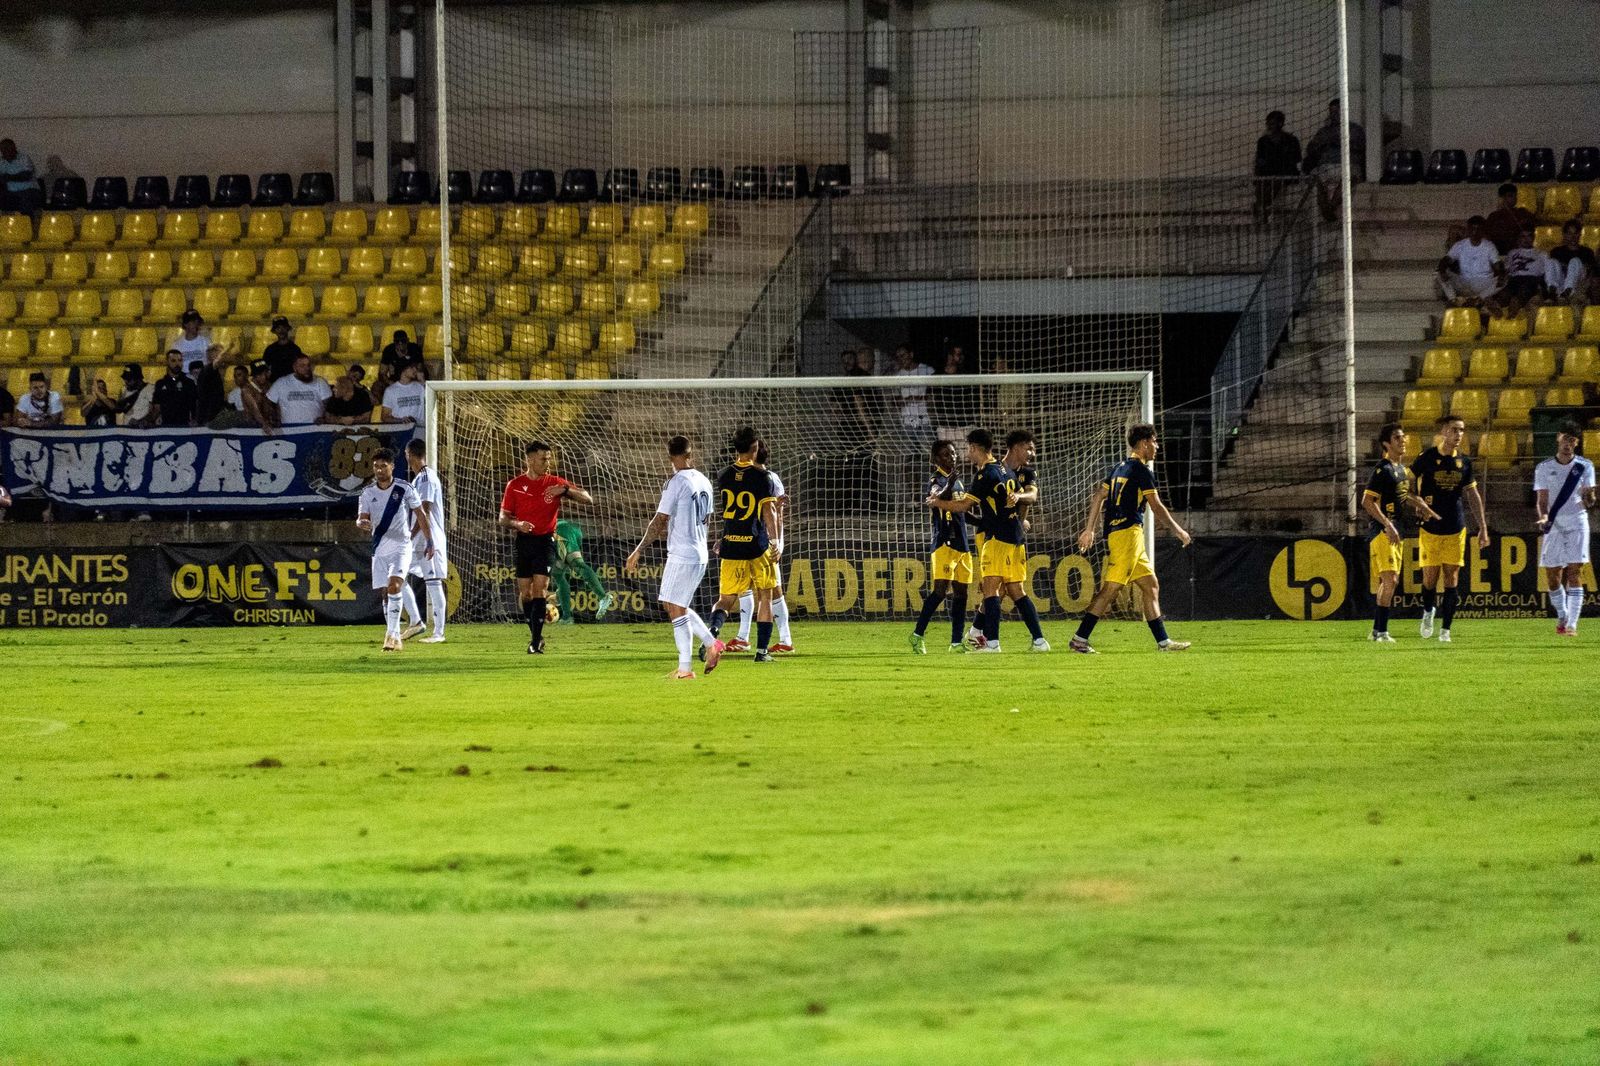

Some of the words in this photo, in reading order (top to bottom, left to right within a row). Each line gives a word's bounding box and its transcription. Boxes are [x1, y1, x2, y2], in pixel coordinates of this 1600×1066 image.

[691, 490, 709, 526] 10
[721, 489, 756, 521] 29
[172, 563, 270, 603] ONE
[274, 559, 357, 600] Fix
[33, 588, 54, 605] El
[57, 587, 128, 606] Terrón
[1463, 592, 1538, 607] AGRÍCOLA
[17, 609, 37, 626] El
[42, 608, 109, 626] Prado
[233, 608, 316, 623] CHRISTIAN
